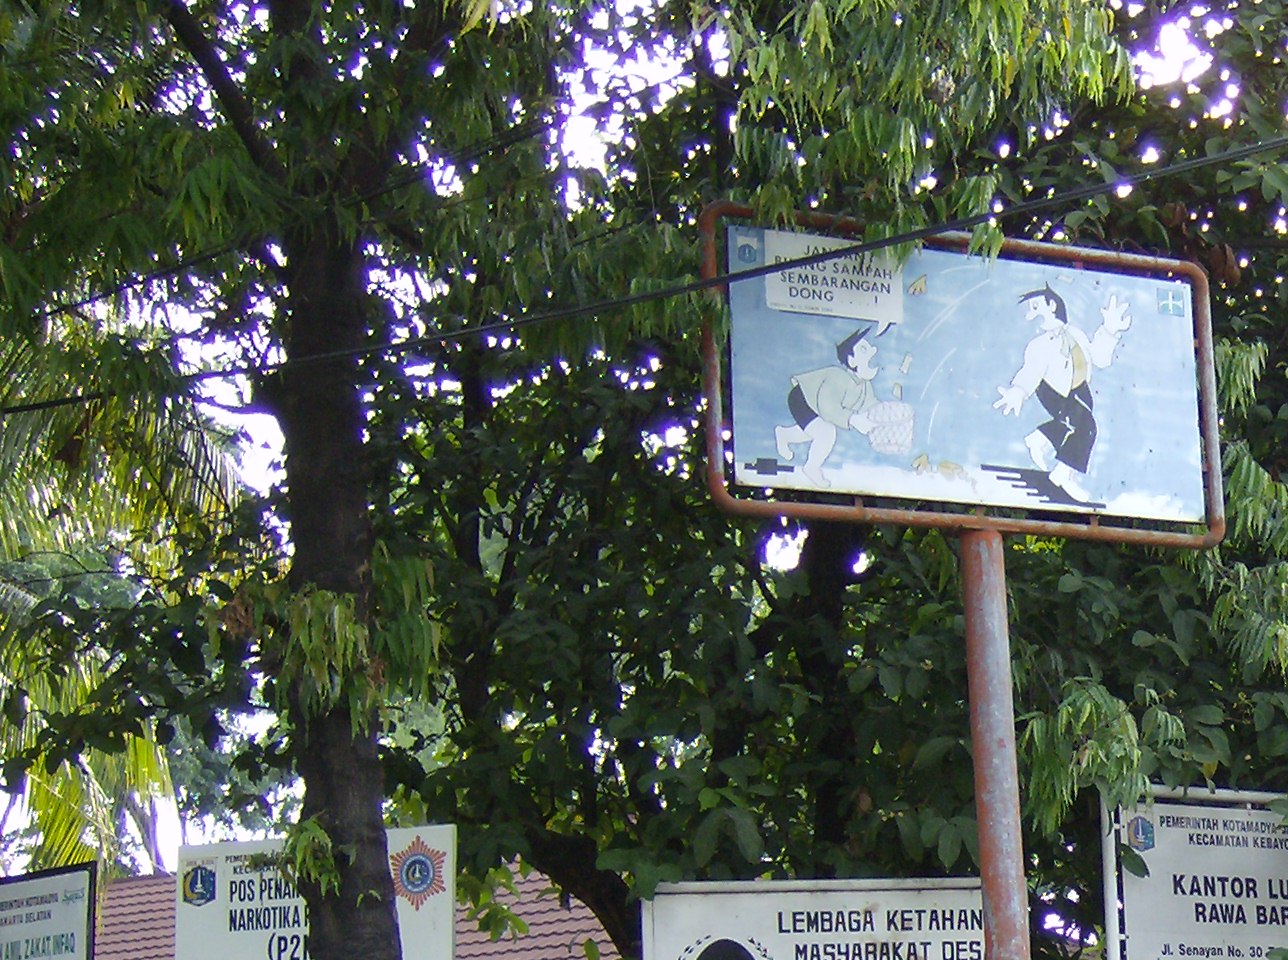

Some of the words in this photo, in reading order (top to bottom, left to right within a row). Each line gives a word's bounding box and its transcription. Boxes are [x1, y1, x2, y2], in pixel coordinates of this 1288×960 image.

[780, 271, 891, 294] SEMBARANGAN
[832, 262, 893, 280] SAMPAH
[788, 286, 834, 302] DONG
[1159, 815, 1218, 831] PEMERINTAH
[1188, 833, 1249, 848] KECAMATAN
[229, 879, 256, 903] POS
[1172, 873, 1258, 899] KANTOR
[229, 904, 301, 932] NARKOTIKA
[777, 909, 876, 935] LEMBAGA
[886, 909, 984, 932] KETAHAN
[1194, 902, 1247, 925] RAWA
[1178, 944, 1224, 958] Senayan
[1228, 945, 1245, 958] No.
[1249, 946, 1263, 958] 30
